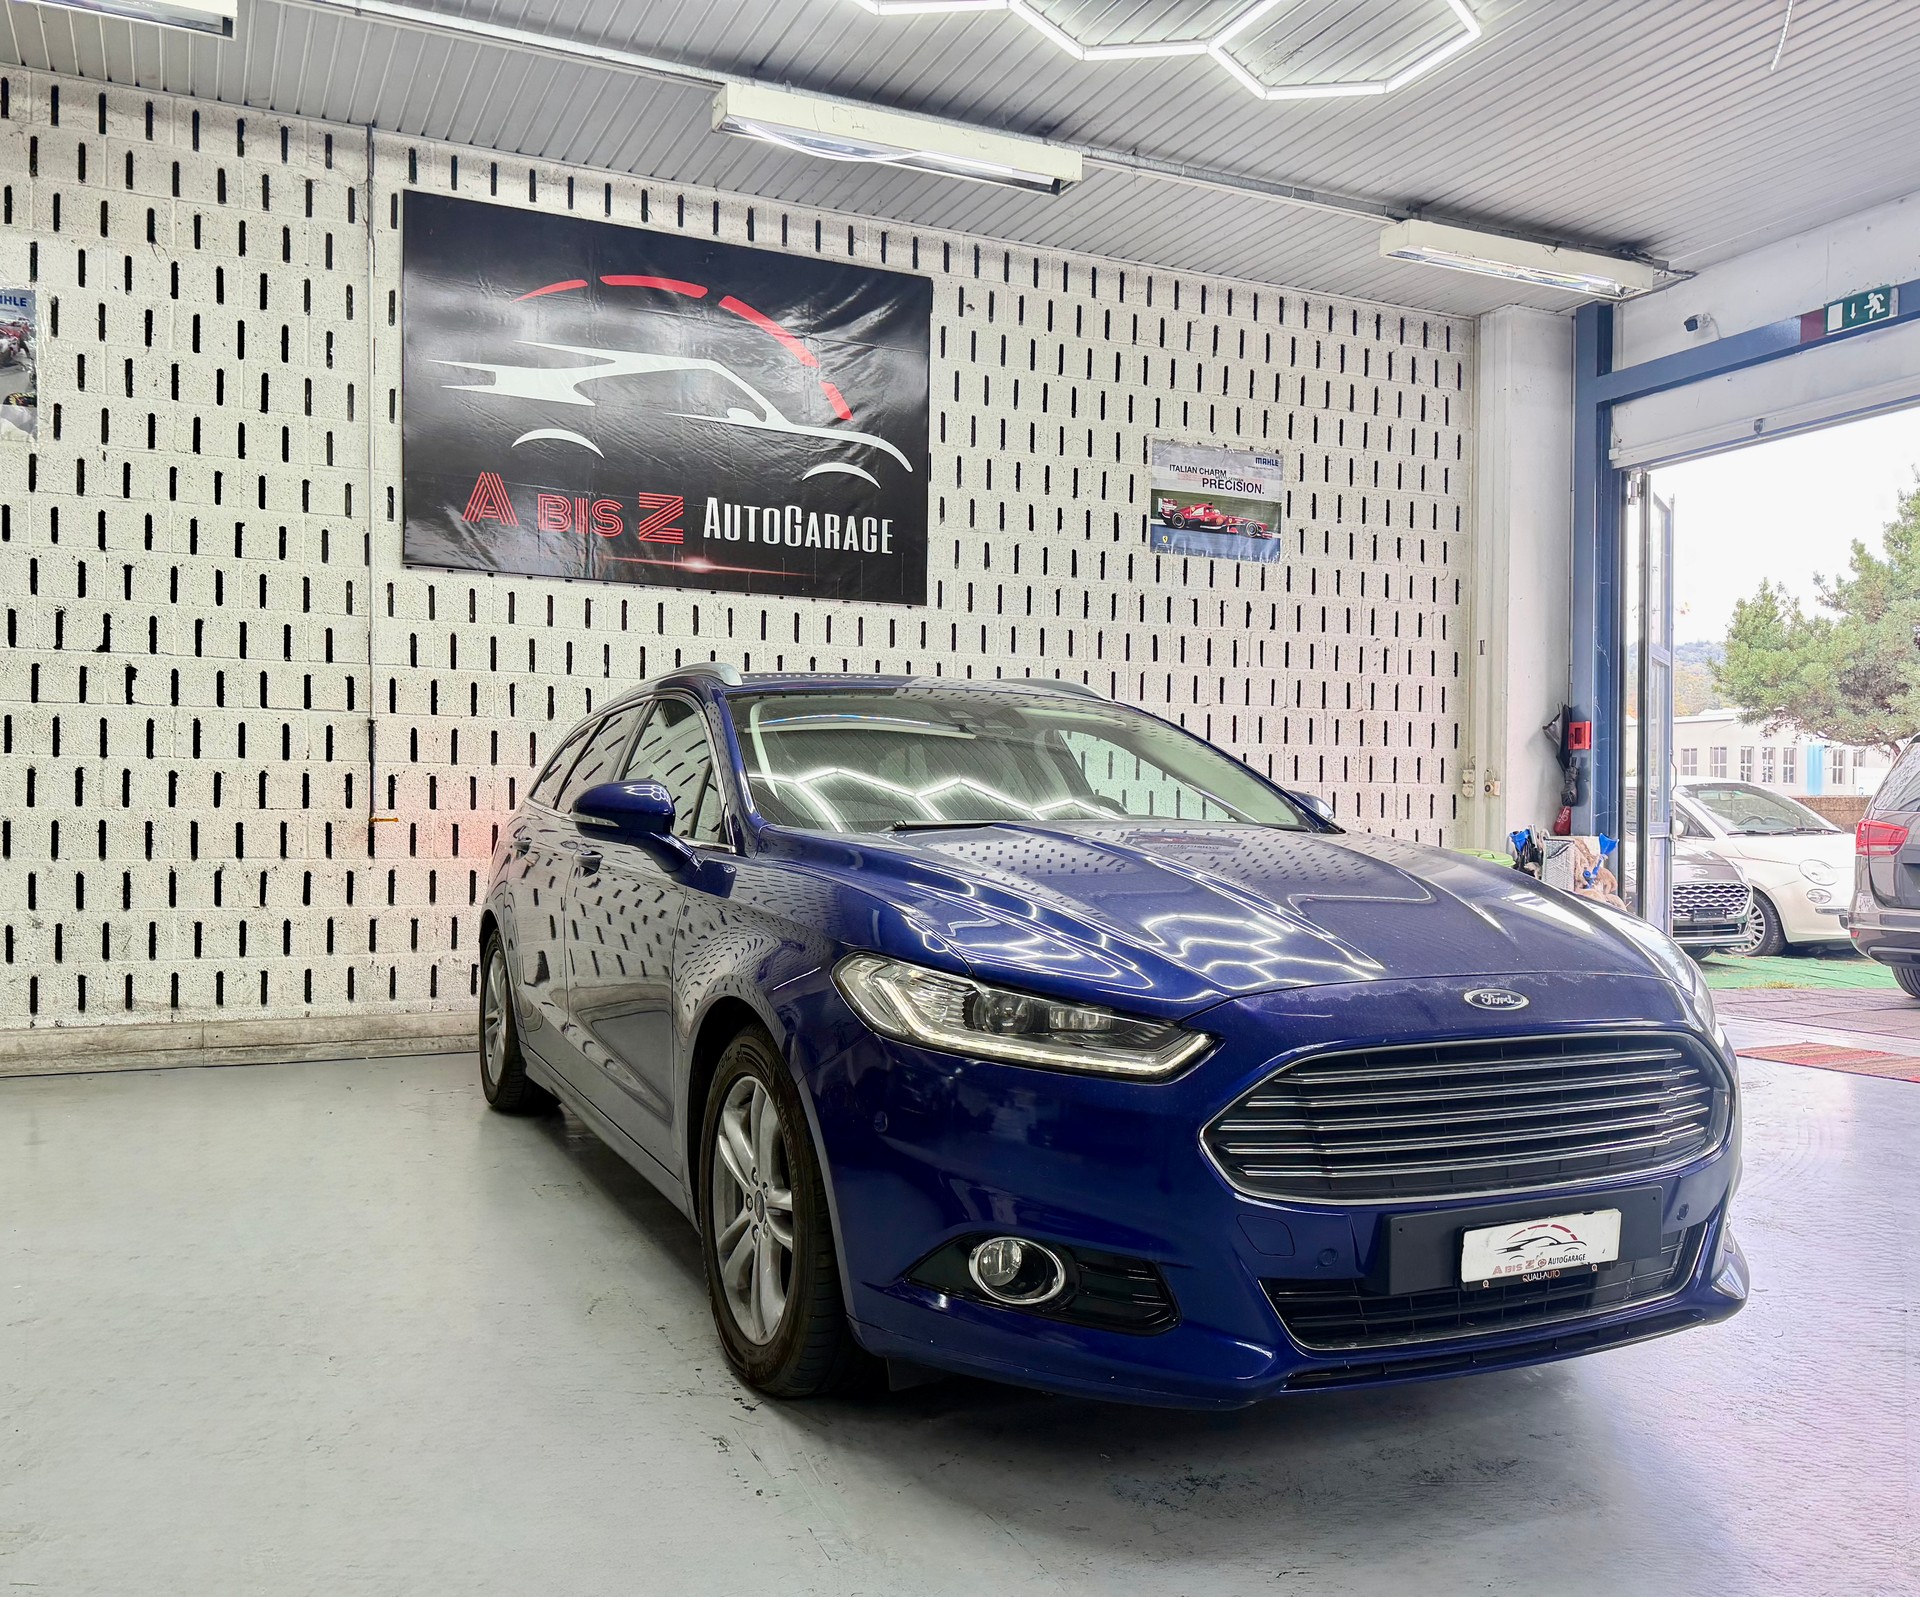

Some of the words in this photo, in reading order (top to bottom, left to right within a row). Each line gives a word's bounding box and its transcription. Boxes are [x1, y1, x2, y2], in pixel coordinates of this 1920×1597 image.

[0, 295, 27, 307] HLE
[1255, 457, 1279, 466] MAHLE
[1169, 464, 1198, 474] ITALIAN
[1199, 467, 1227, 478] CHARM
[1202, 478, 1265, 495] PRECISION.
[462, 471, 519, 527] A
[537, 493, 624, 537] BIS
[638, 491, 684, 544] Z
[703, 497, 894, 554] AUTOGARAGE
[1480, 992, 1522, 1005] Ford
[1492, 1265, 1503, 1276] A
[1504, 1263, 1523, 1273] BIS
[1547, 1254, 1587, 1266] AUTOGARAGE
